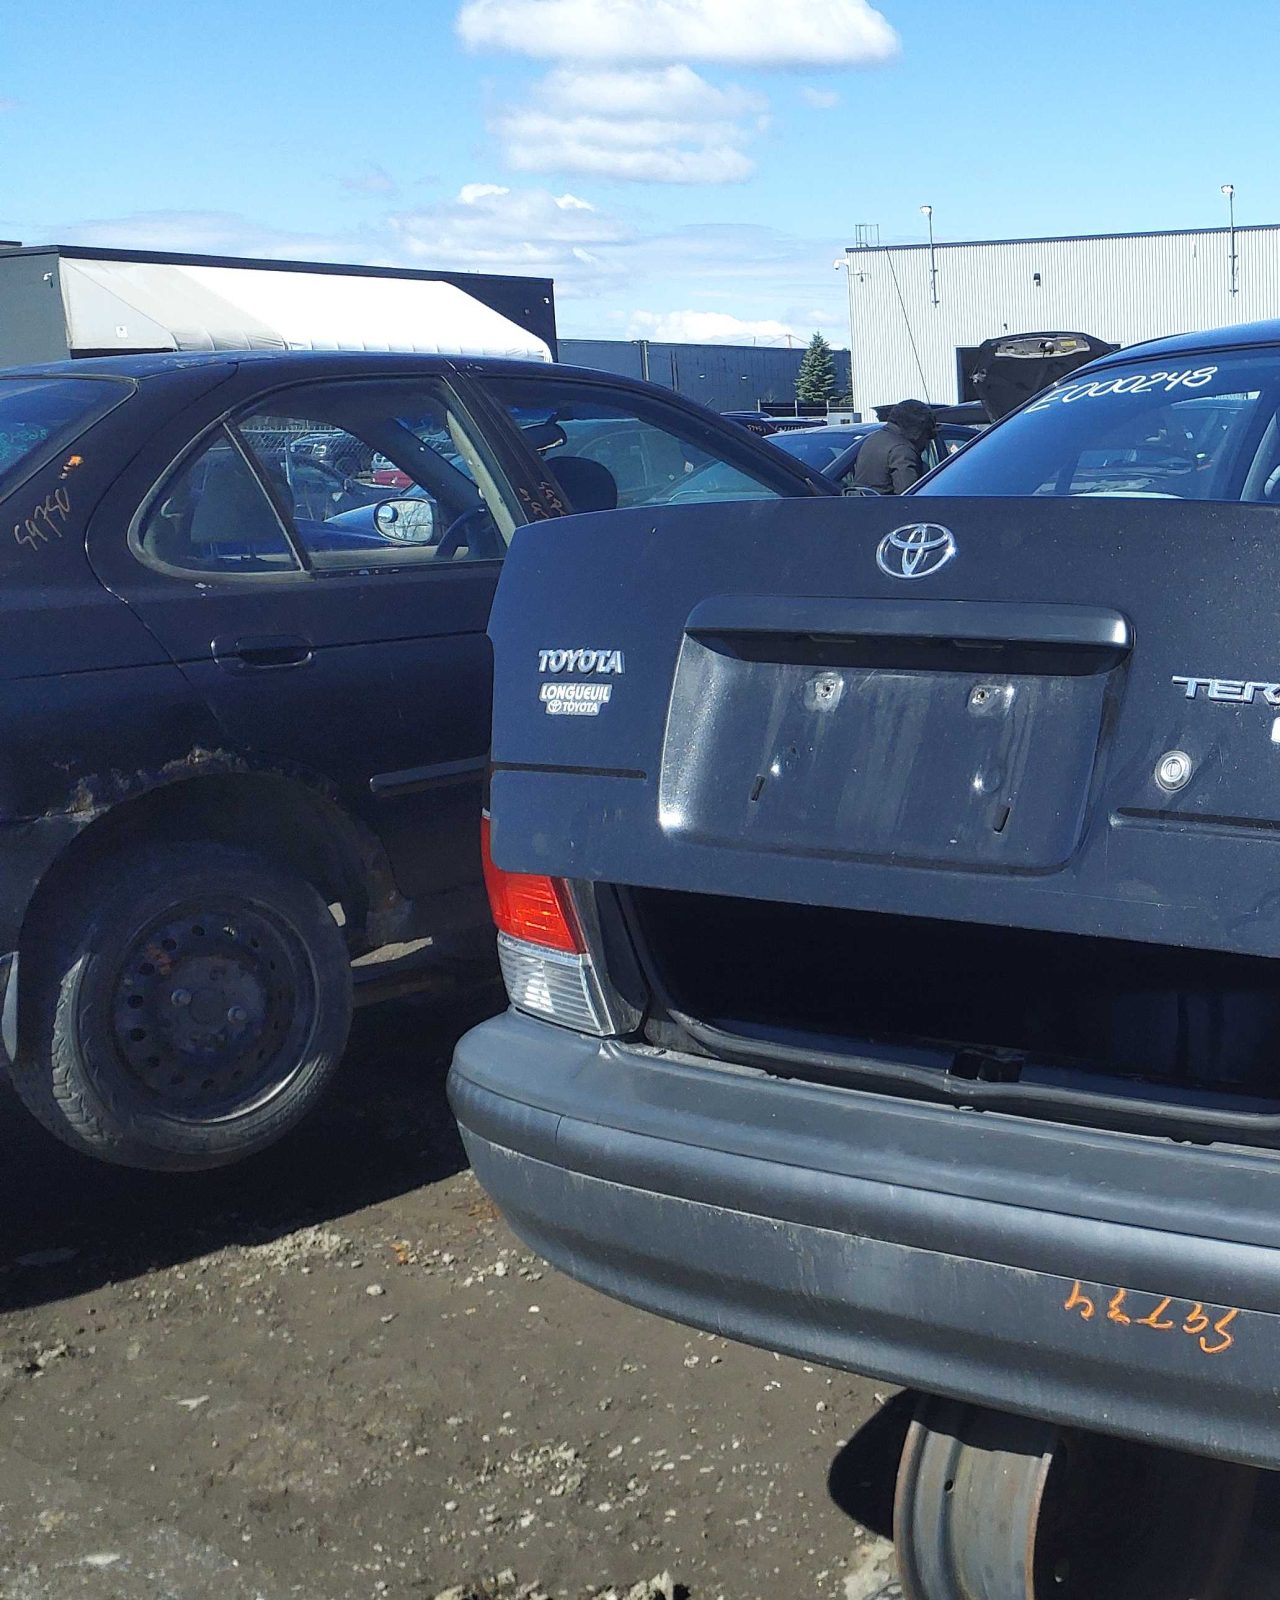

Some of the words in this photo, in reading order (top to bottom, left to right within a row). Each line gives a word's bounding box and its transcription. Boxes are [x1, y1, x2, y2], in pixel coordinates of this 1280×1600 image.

[538, 649, 625, 674] TOYOTA
[541, 685, 610, 700] LONGUEUIL
[562, 701, 598, 713] TOYOTA
